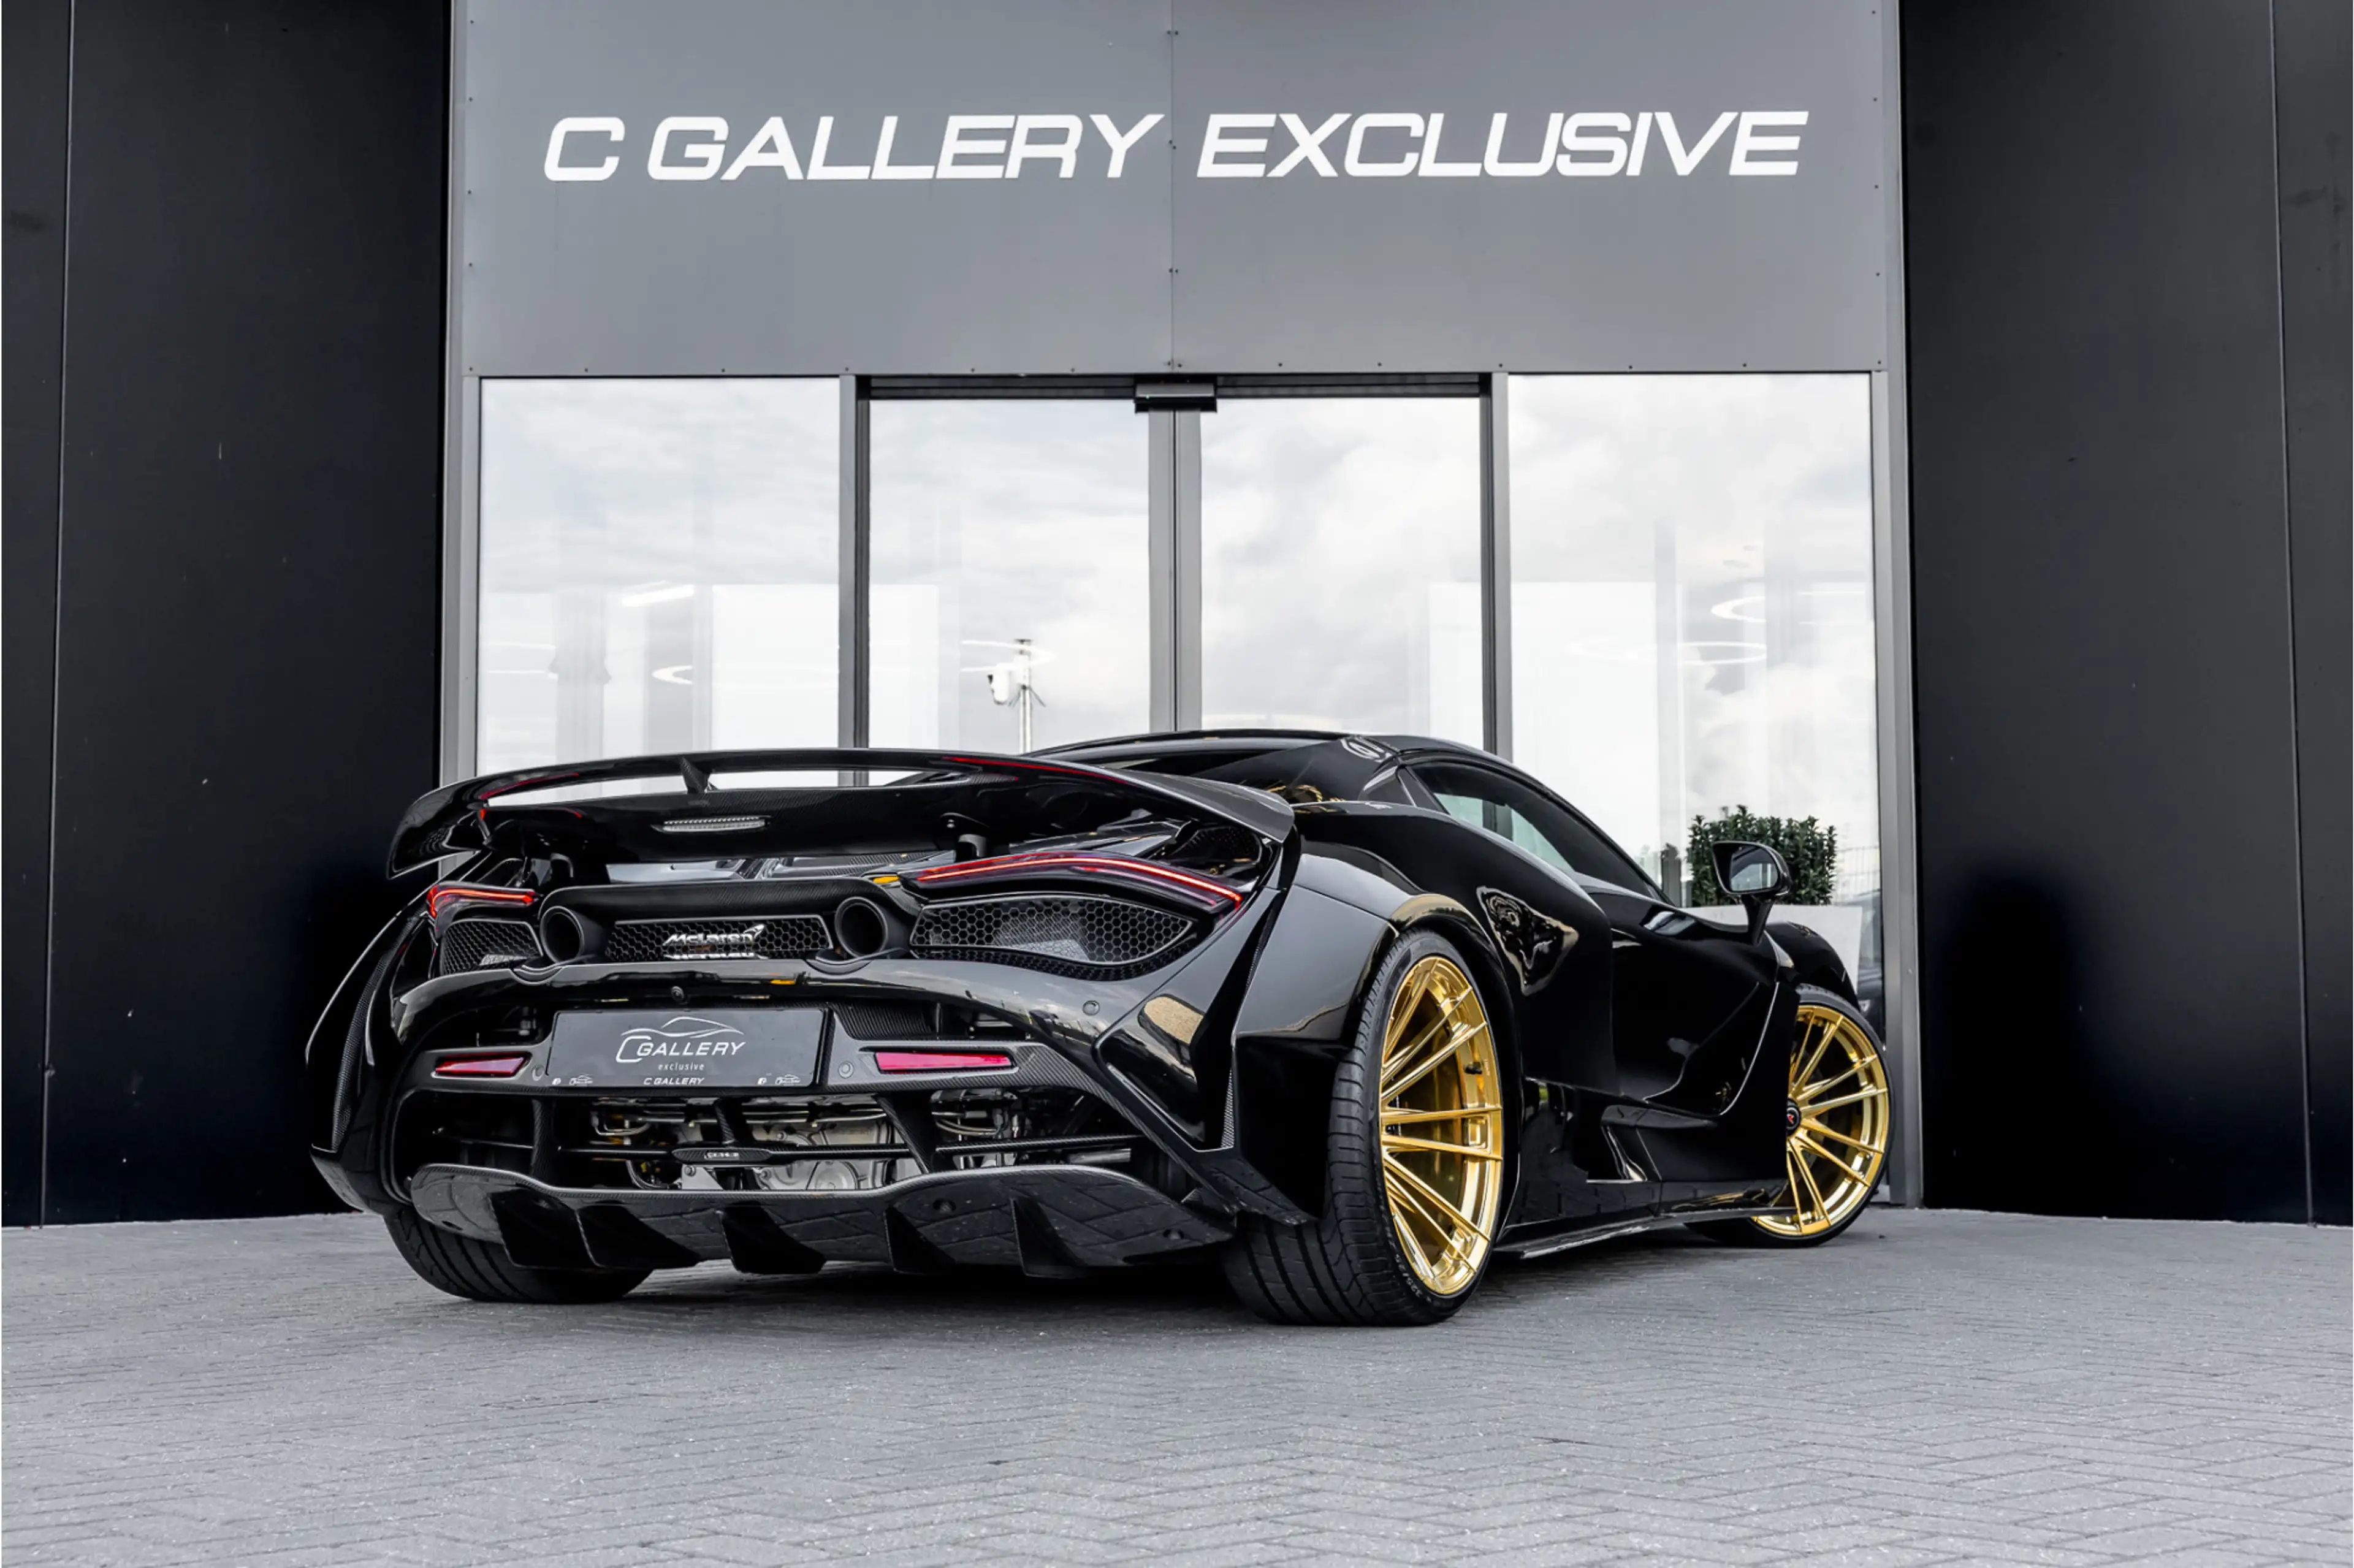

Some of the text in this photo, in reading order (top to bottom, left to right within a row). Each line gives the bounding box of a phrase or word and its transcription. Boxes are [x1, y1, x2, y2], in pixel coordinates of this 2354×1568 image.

[544, 111, 1809, 181] C GALLERY EXCLUSIVE
[663, 932, 753, 946] McLaren
[658, 1062, 705, 1071] exclusive
[643, 1077, 705, 1086] C GALLERY
